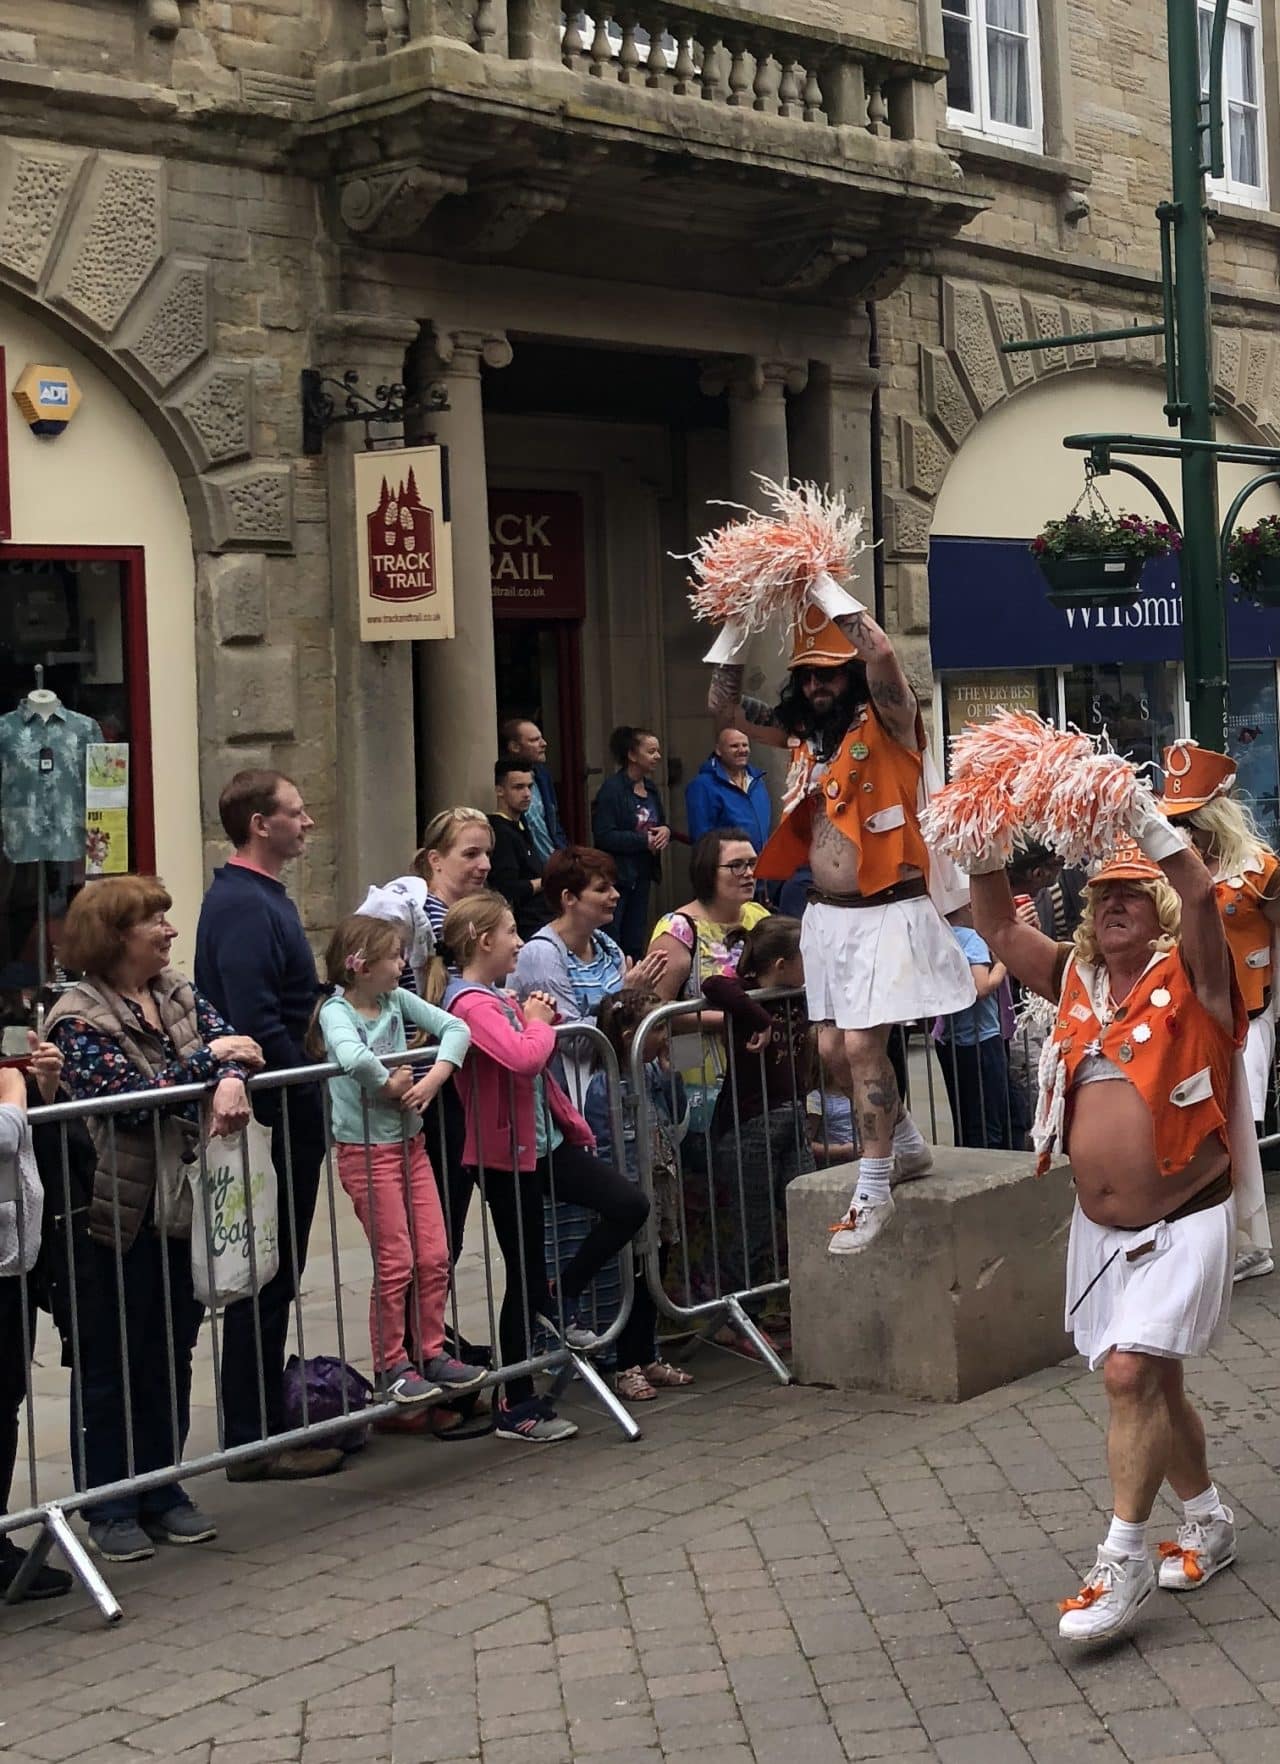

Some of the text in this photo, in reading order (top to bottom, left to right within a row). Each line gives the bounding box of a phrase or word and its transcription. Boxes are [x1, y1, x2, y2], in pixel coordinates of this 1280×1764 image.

[40, 386, 68, 401] ADT
[373, 552, 431, 573] TRACK
[386, 571, 432, 589] TRAIL
[957, 685, 1035, 701] THE VERY BEST
[967, 702, 1029, 717] OF BRTAIN
